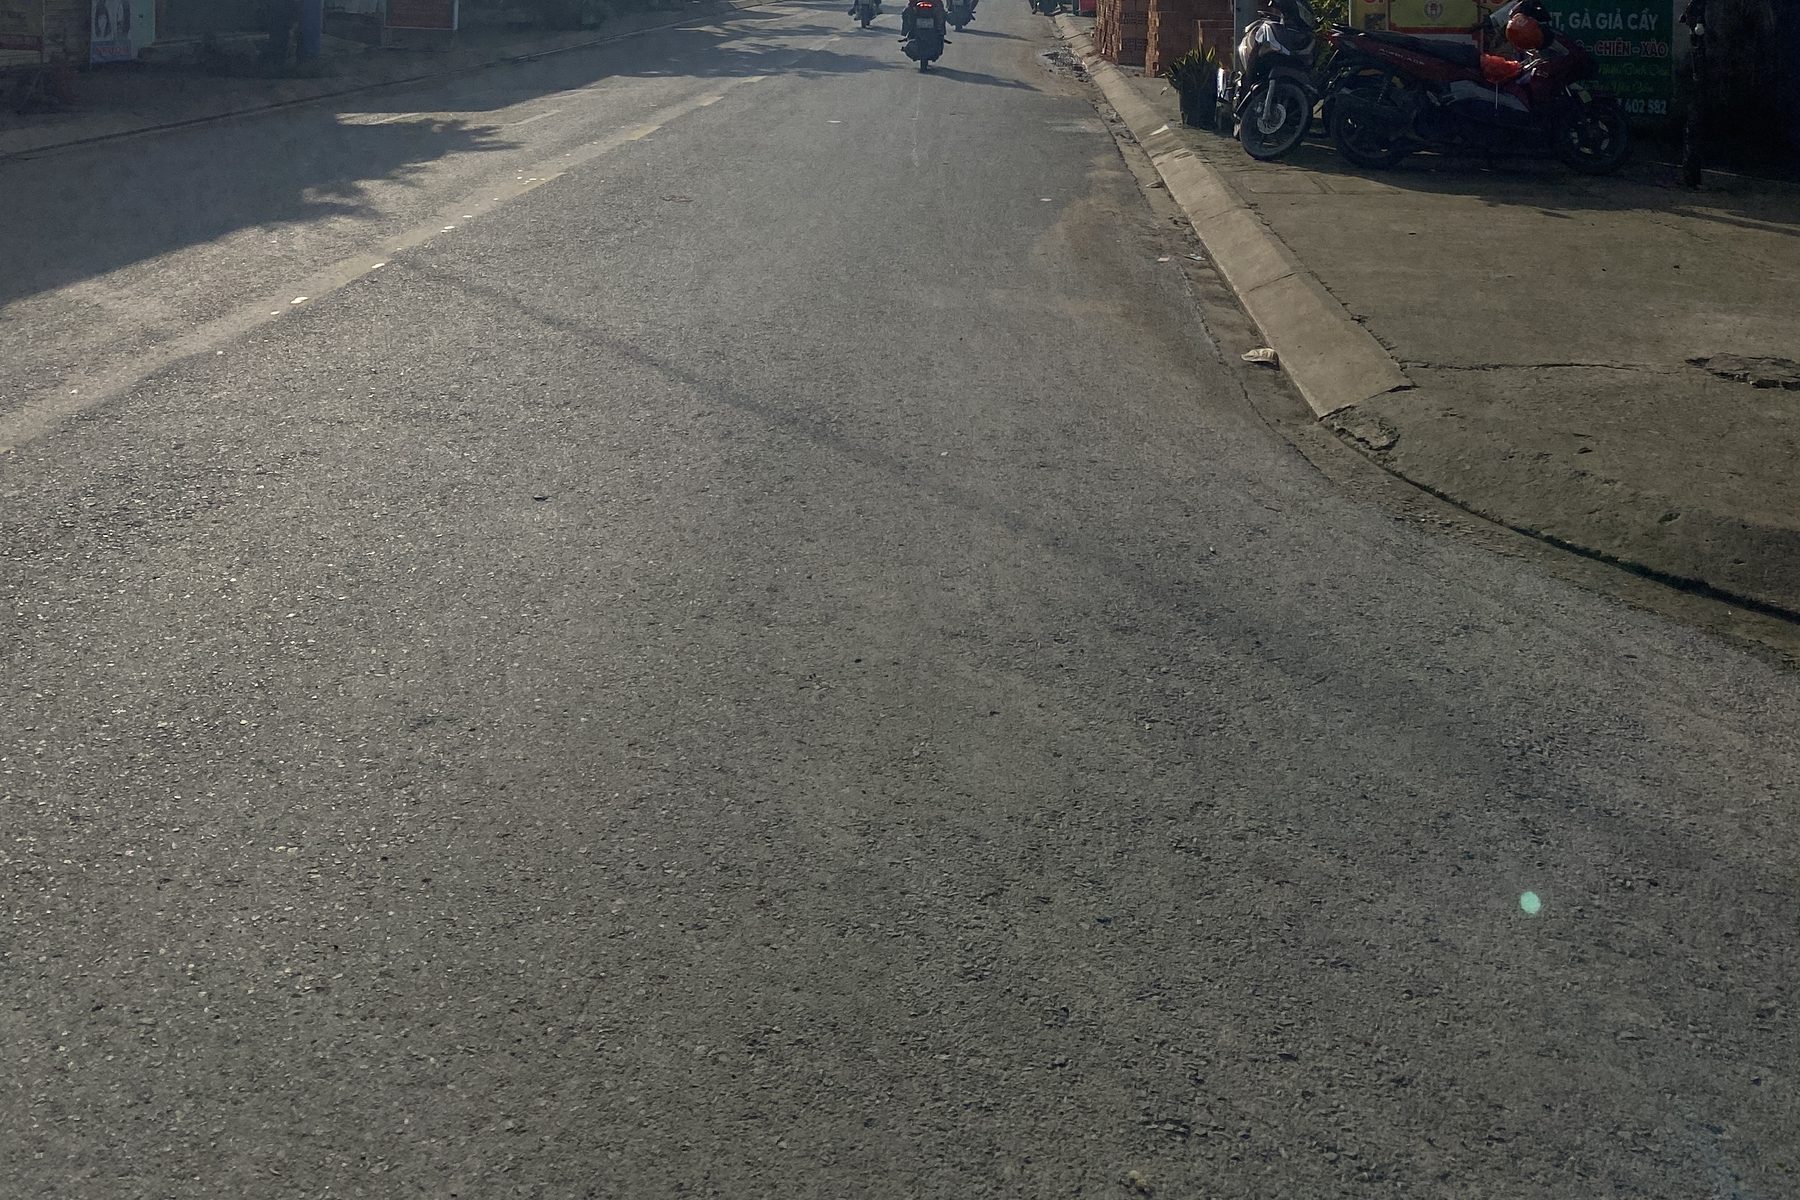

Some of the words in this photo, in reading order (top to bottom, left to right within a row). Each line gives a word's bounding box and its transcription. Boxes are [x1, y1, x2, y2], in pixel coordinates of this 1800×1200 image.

[1568, 8, 1593, 30] GÀ
[1595, 8, 1625, 31] GIẢ
[1594, 38, 1632, 58] CHIÊN
[1640, 38, 1669, 58] XÀO
